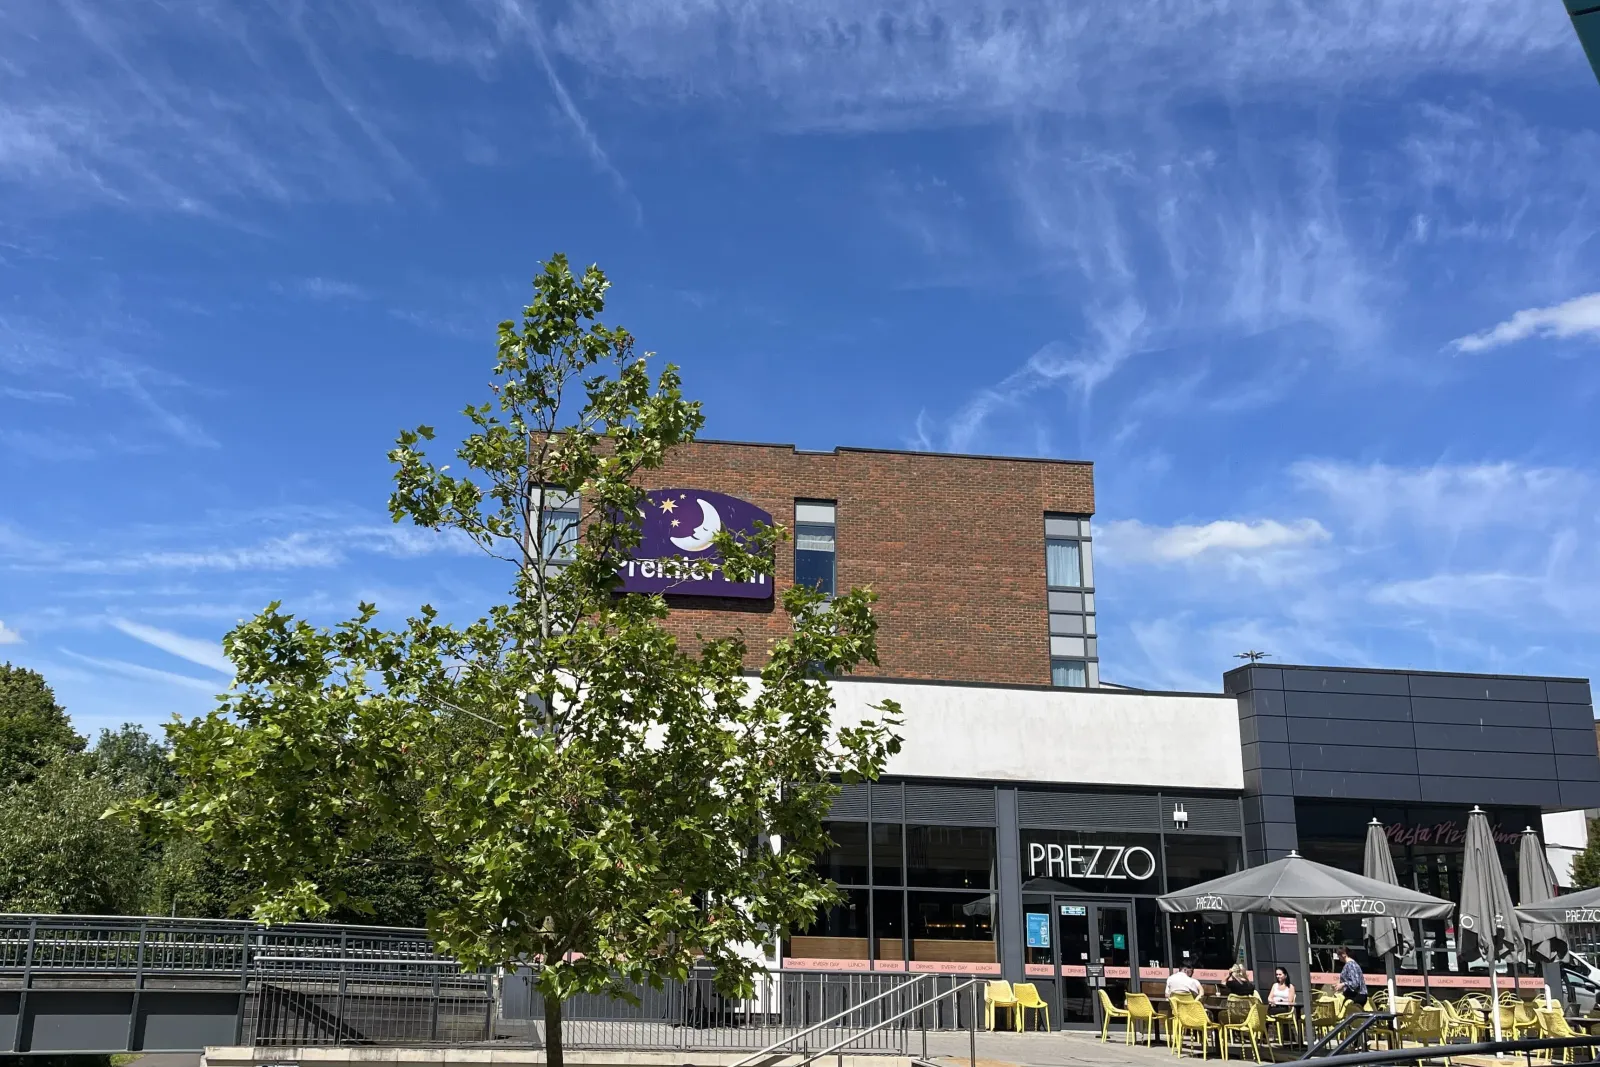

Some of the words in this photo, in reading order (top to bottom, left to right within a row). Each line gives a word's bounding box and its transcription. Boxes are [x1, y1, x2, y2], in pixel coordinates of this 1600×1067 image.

[1384, 822, 1433, 846] Pasta
[1027, 842, 1156, 880] PREZZO
[1195, 895, 1223, 910] PREZZO
[1340, 898, 1386, 915] PREZZO
